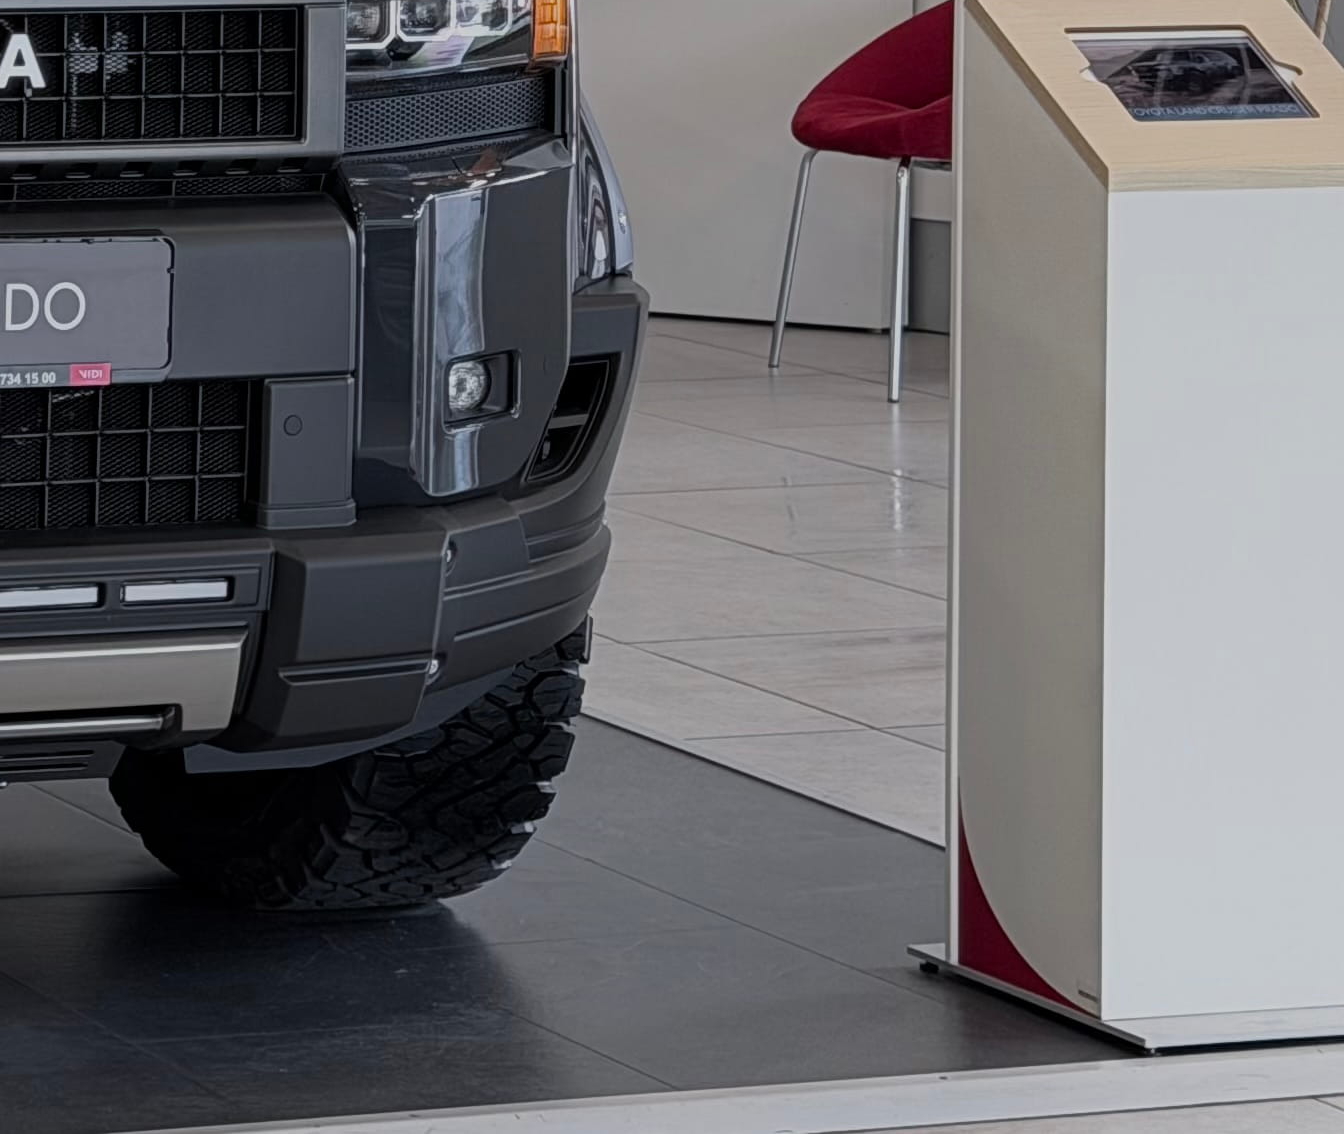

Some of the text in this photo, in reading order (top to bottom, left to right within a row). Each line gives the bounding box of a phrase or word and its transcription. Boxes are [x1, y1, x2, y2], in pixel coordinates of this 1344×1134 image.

[0, 372, 22, 386] 734
[24, 372, 39, 385] 15
[40, 371, 56, 385] 00
[78, 368, 103, 380] VIDI
